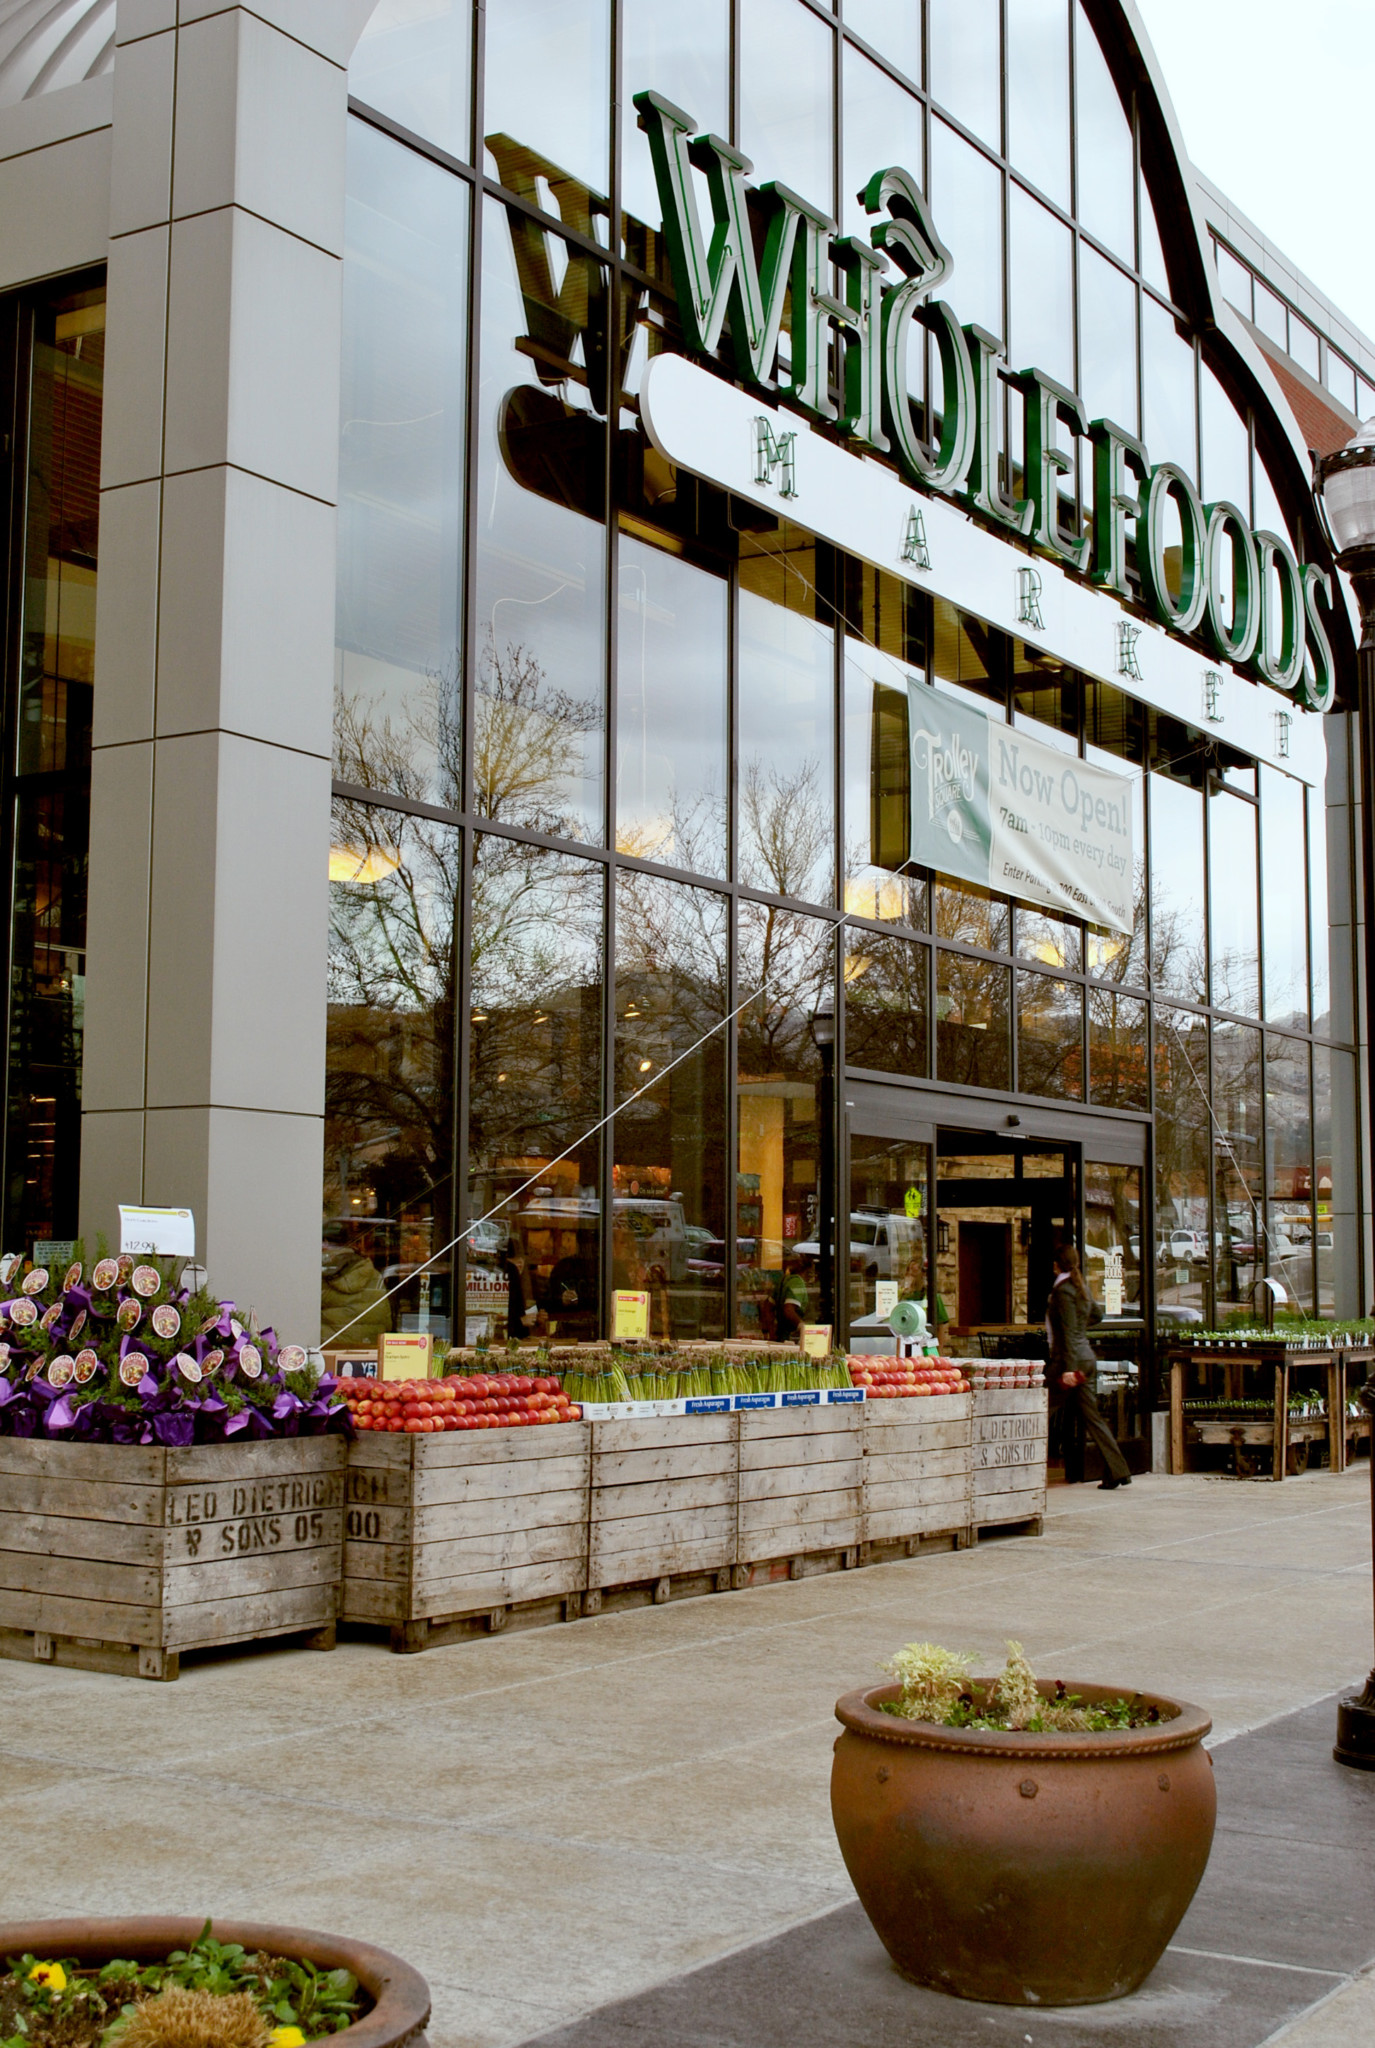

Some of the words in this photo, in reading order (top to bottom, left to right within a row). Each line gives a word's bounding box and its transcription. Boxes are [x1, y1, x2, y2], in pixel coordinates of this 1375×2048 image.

[632, 90, 1090, 570] WHOLE
[1090, 417, 1335, 713] FOODS
[751, 415, 1292, 760] MARKET
[935, 784, 961, 808] SQUARE
[998, 738, 1054, 807] Now
[1060, 769, 1128, 837] Open!
[1000, 806, 1028, 834] 7am
[1039, 823, 1071, 852] 10pm
[1073, 838, 1105, 869] every
[1107, 844, 1128, 877] day
[1003, 862, 1024, 881] Enter
[995, 1443, 1020, 1464] SONS
[221, 1517, 281, 1553] SONS
